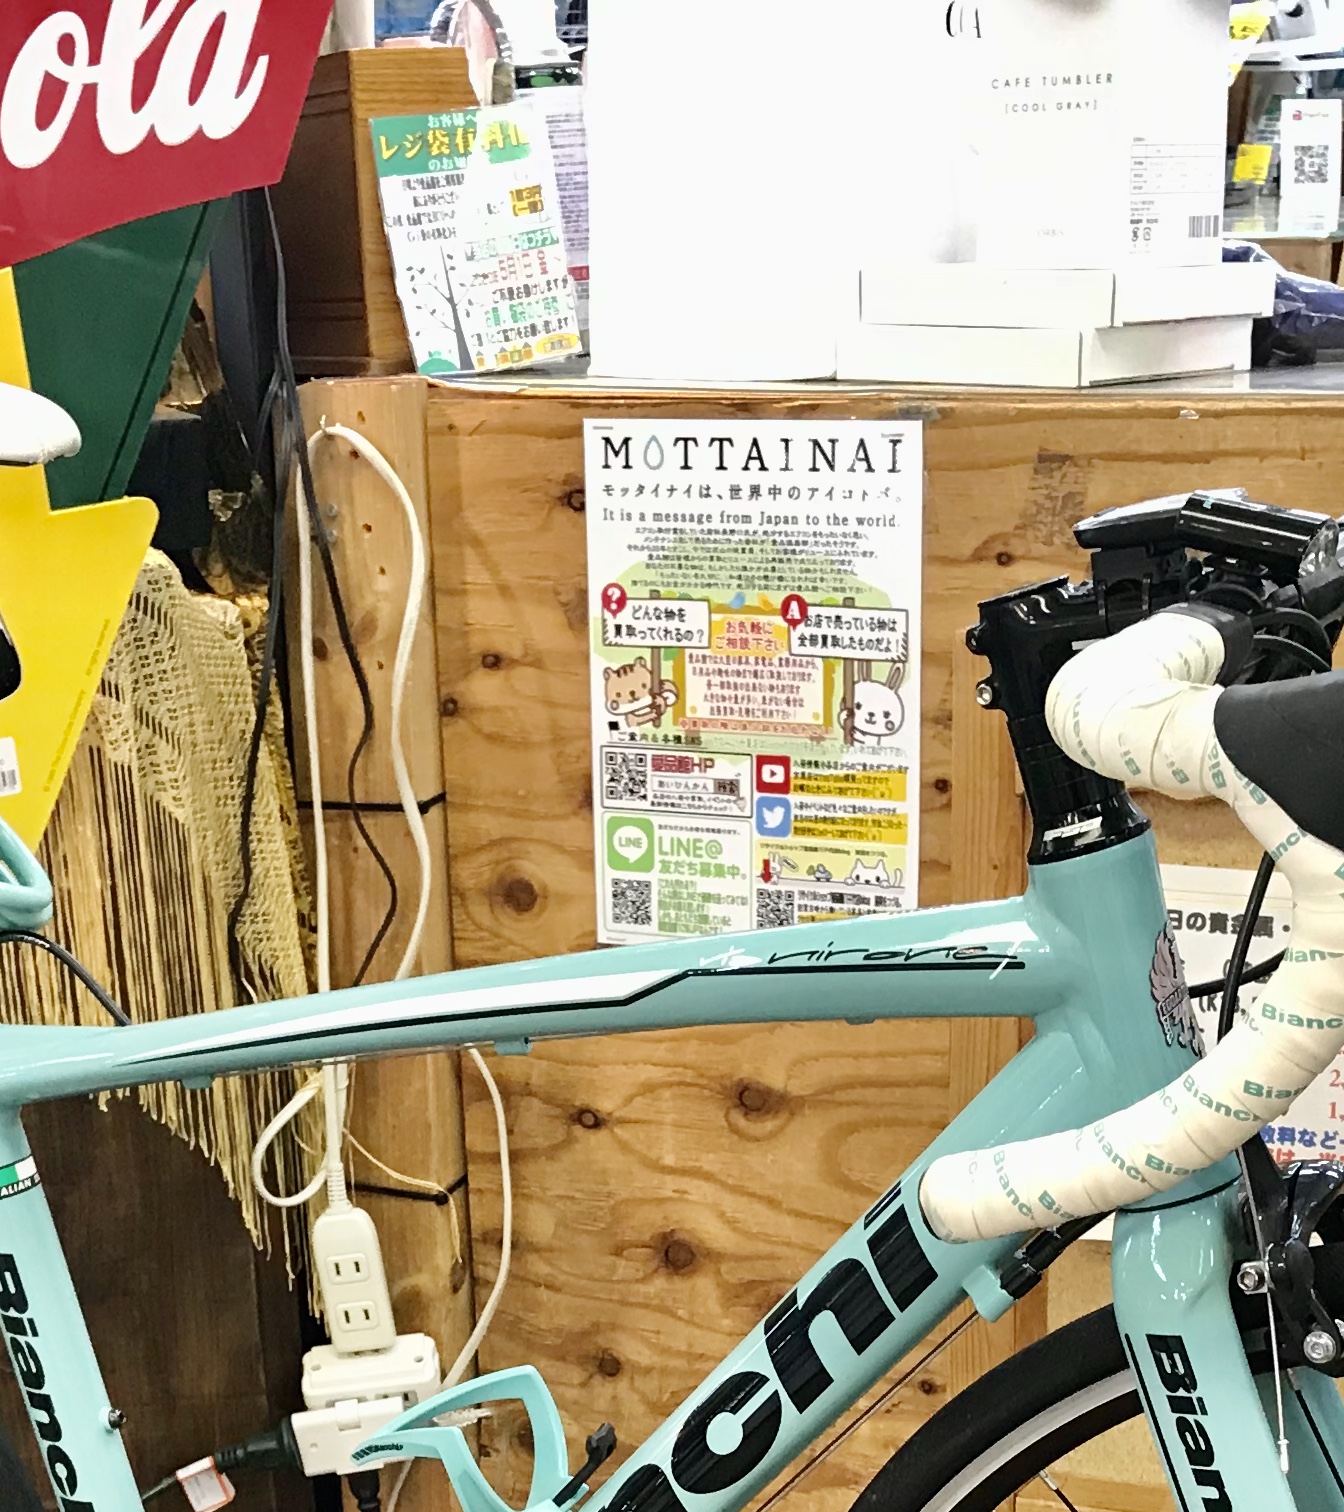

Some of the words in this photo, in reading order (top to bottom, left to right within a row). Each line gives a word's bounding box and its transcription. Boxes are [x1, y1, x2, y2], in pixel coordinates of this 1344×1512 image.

[991, 77, 1032, 90] CAFE
[1042, 73, 1114, 87] TUMBLER
[601, 434, 904, 473] MOTTAINAI
[602, 508, 616, 521] It
[620, 509, 633, 522] is
[639, 512, 647, 522] a
[652, 511, 713, 526] message
[720, 510, 753, 524] from
[759, 512, 799, 528] Japan
[806, 514, 820, 526] to
[826, 513, 850, 527] the
[618, 836, 643, 849] LINE
[658, 836, 724, 860] LINE@
